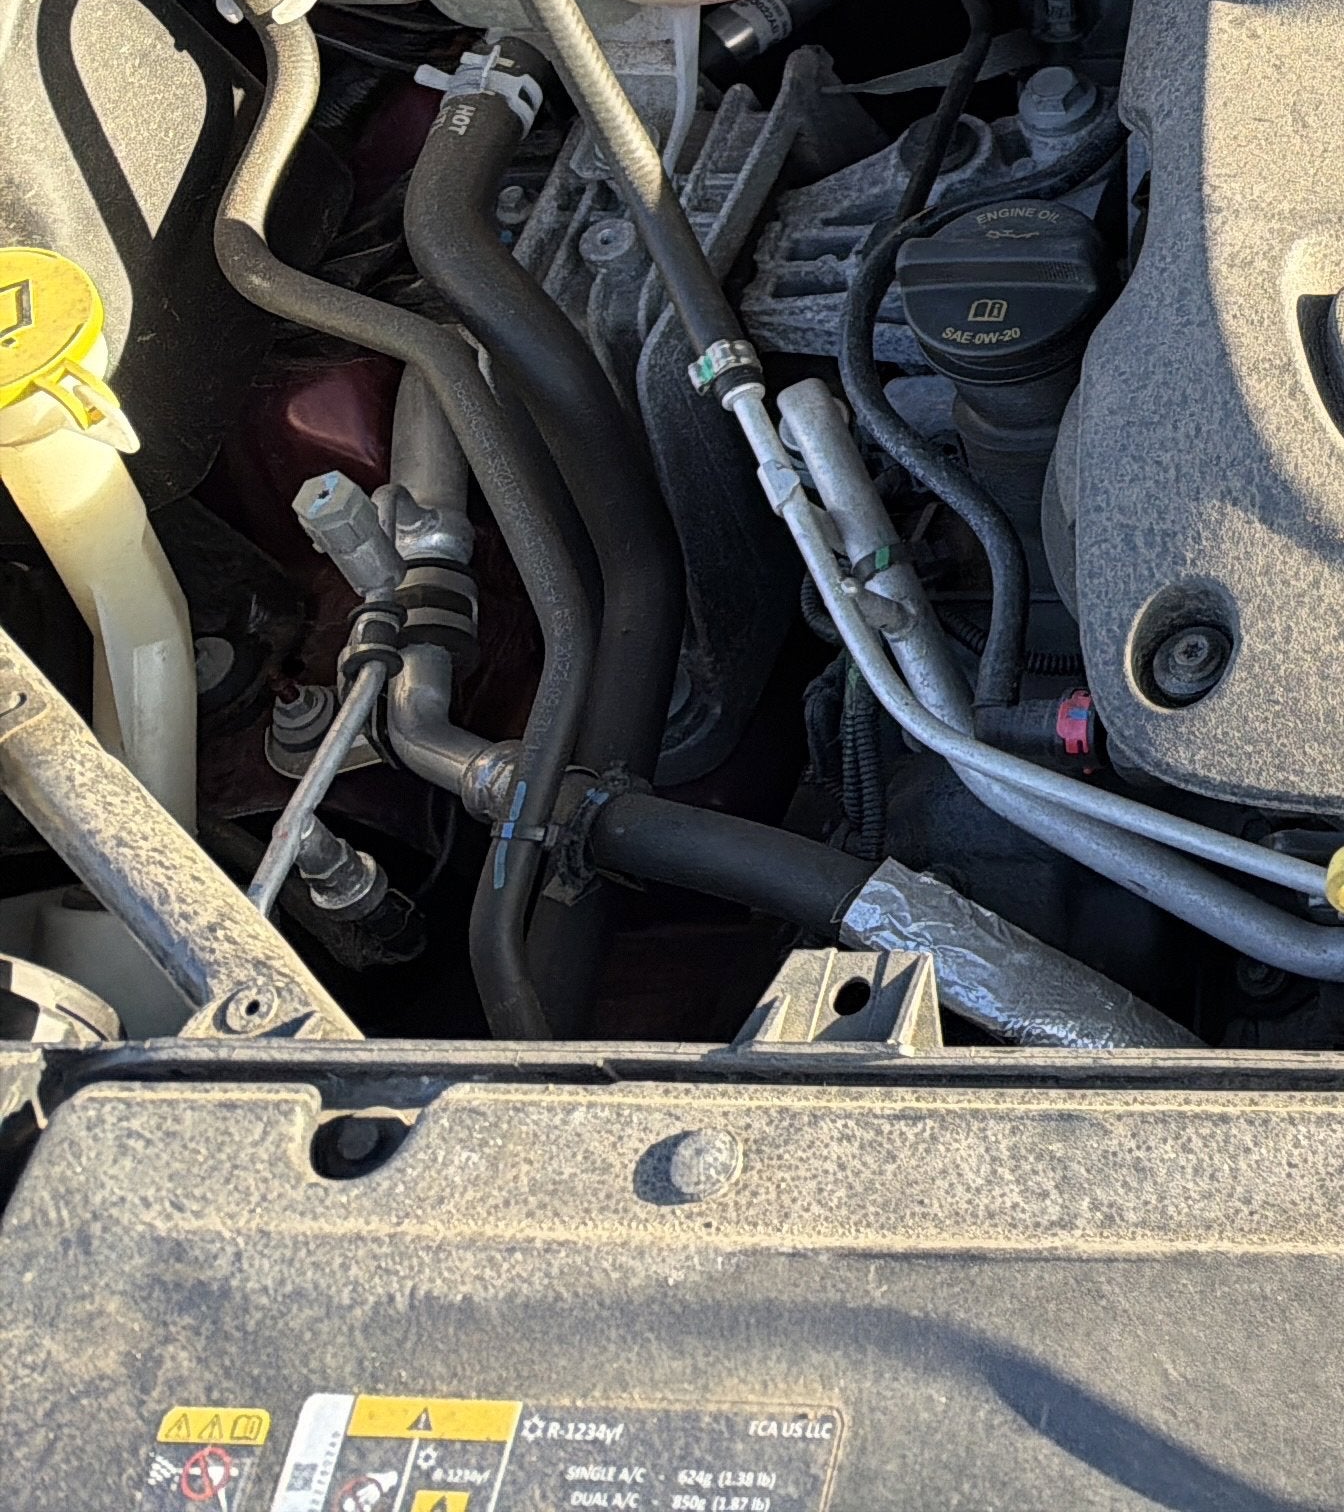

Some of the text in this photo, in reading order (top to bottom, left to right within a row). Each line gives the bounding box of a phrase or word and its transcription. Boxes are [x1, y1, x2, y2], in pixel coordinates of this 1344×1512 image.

[976, 207, 1061, 226] ENGINE OIL
[941, 326, 1022, 345] SAE 0W-20
[546, 1419, 833, 1445] R-1234yf FCA US LLC
[564, 1465, 616, 1483] SINGLE
[618, 1467, 647, 1484] A/C
[569, 1490, 609, 1507] DUAL
[611, 1491, 641, 1508] A/C
